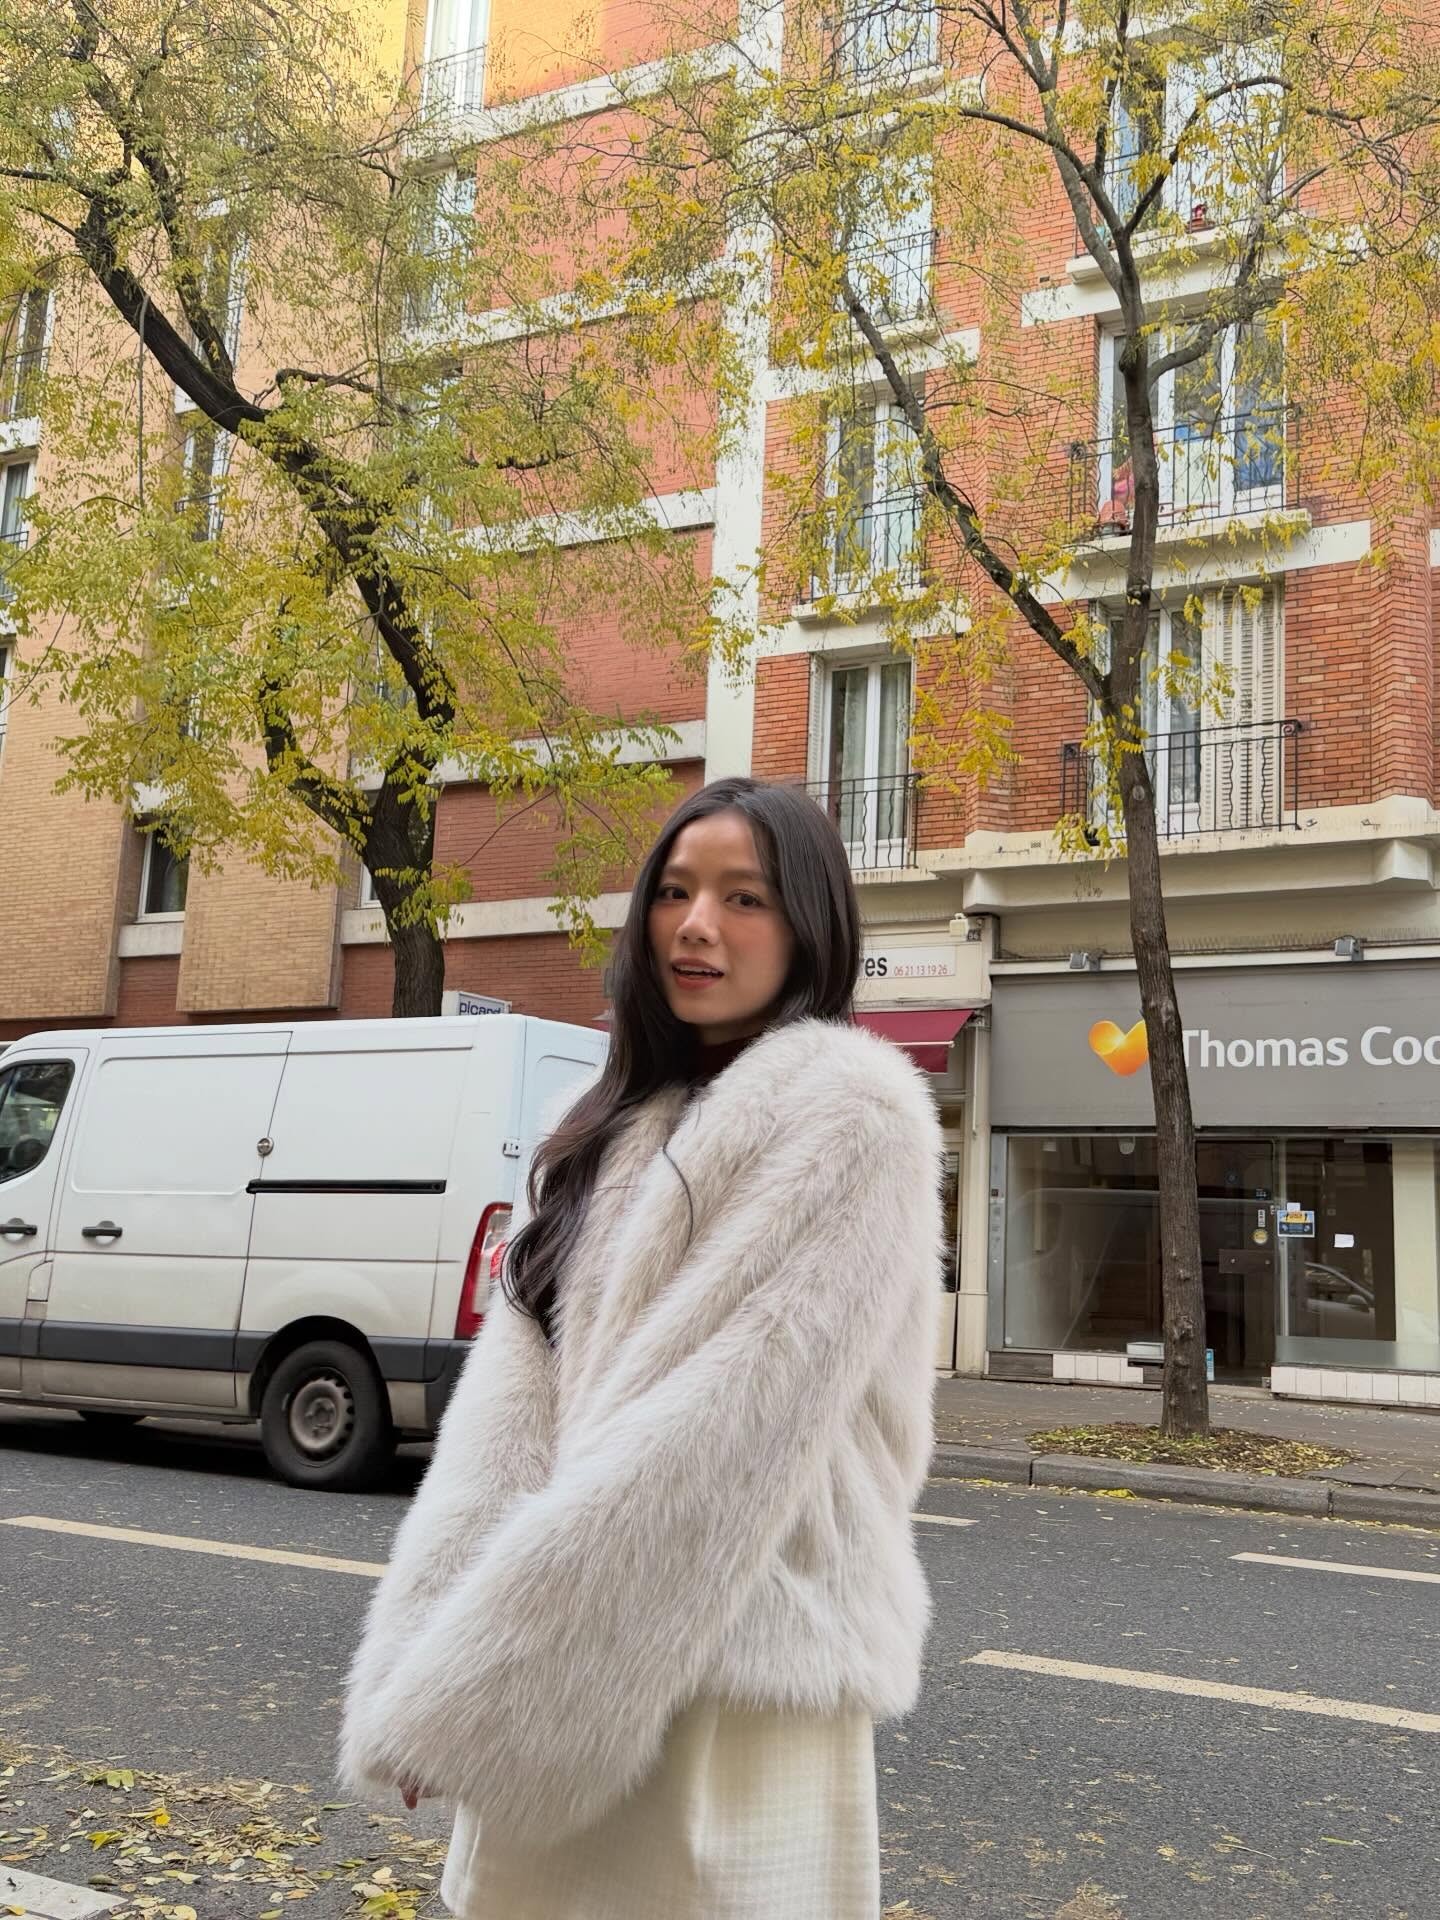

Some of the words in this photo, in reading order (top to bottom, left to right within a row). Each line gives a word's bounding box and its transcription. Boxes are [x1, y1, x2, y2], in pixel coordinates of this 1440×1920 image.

[894, 965, 904, 977] 06
[905, 965, 914, 976] 21
[916, 965, 925, 976] 13
[928, 964, 937, 975] 19
[938, 964, 948, 975] 26
